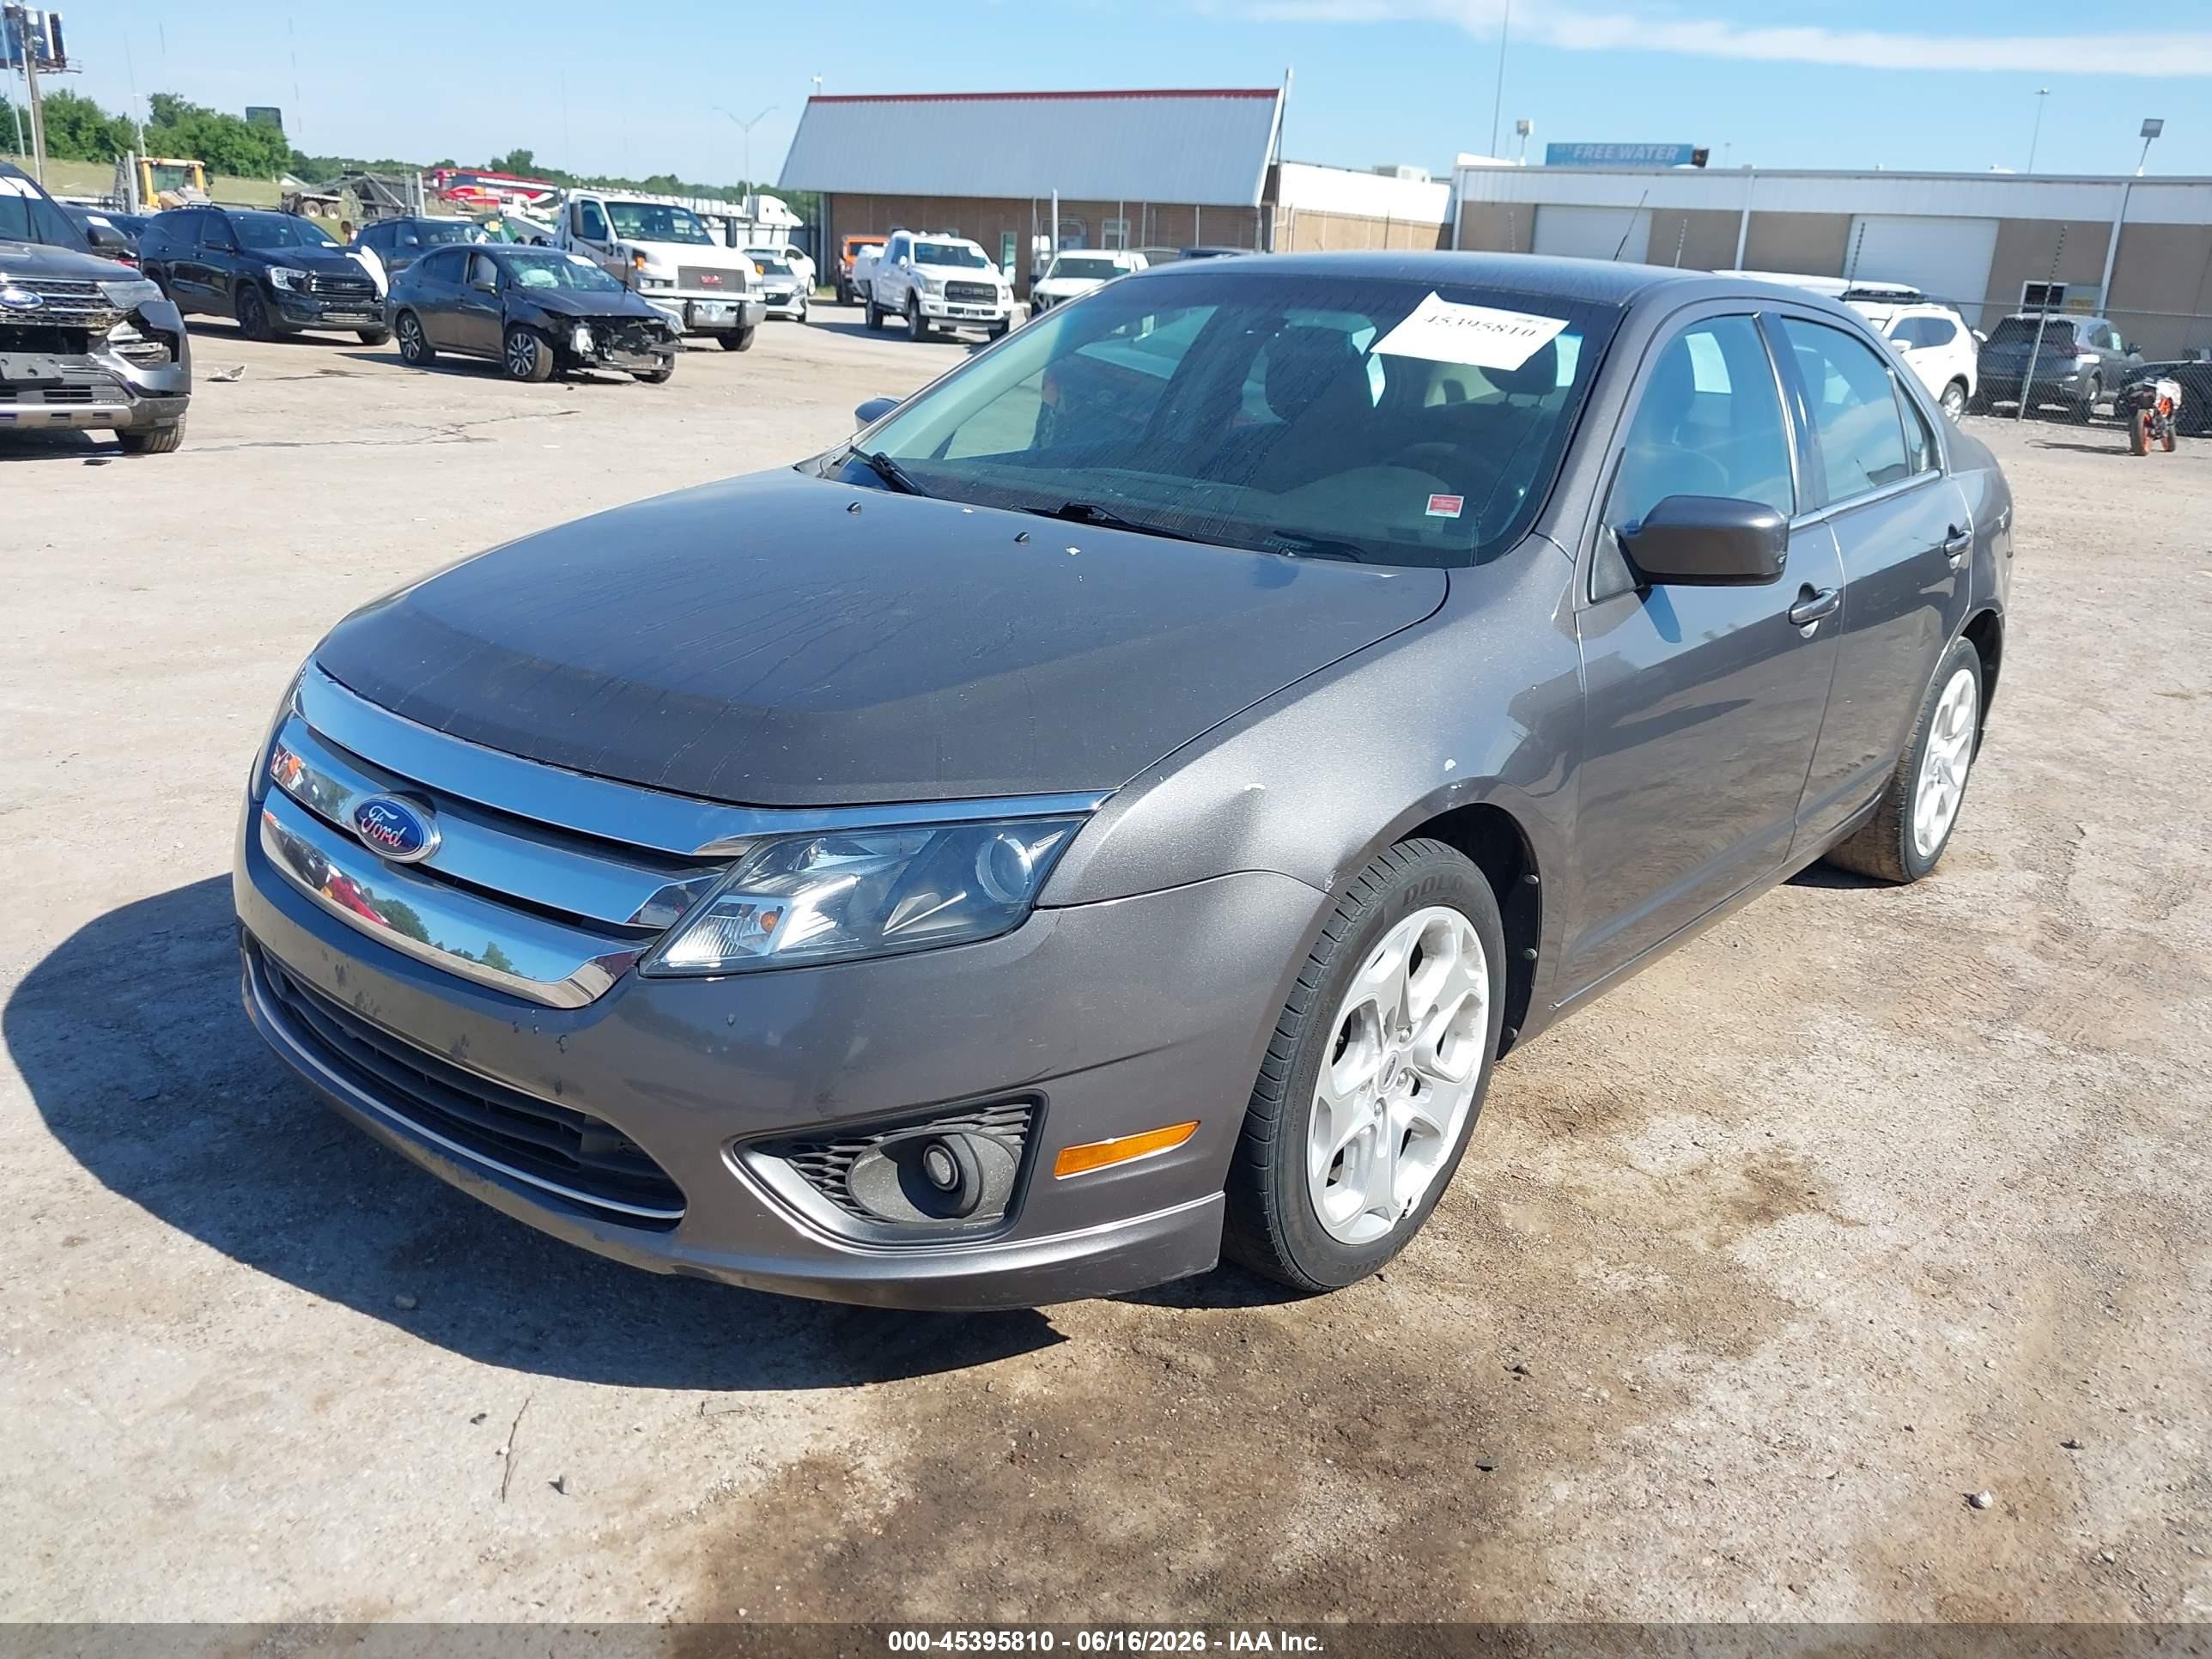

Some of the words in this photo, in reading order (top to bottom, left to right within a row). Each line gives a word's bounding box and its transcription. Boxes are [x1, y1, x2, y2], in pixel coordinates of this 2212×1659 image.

[1572, 144, 1615, 160] FREE
[1620, 144, 1680, 161] WATER
[360, 805, 408, 848] Ford
